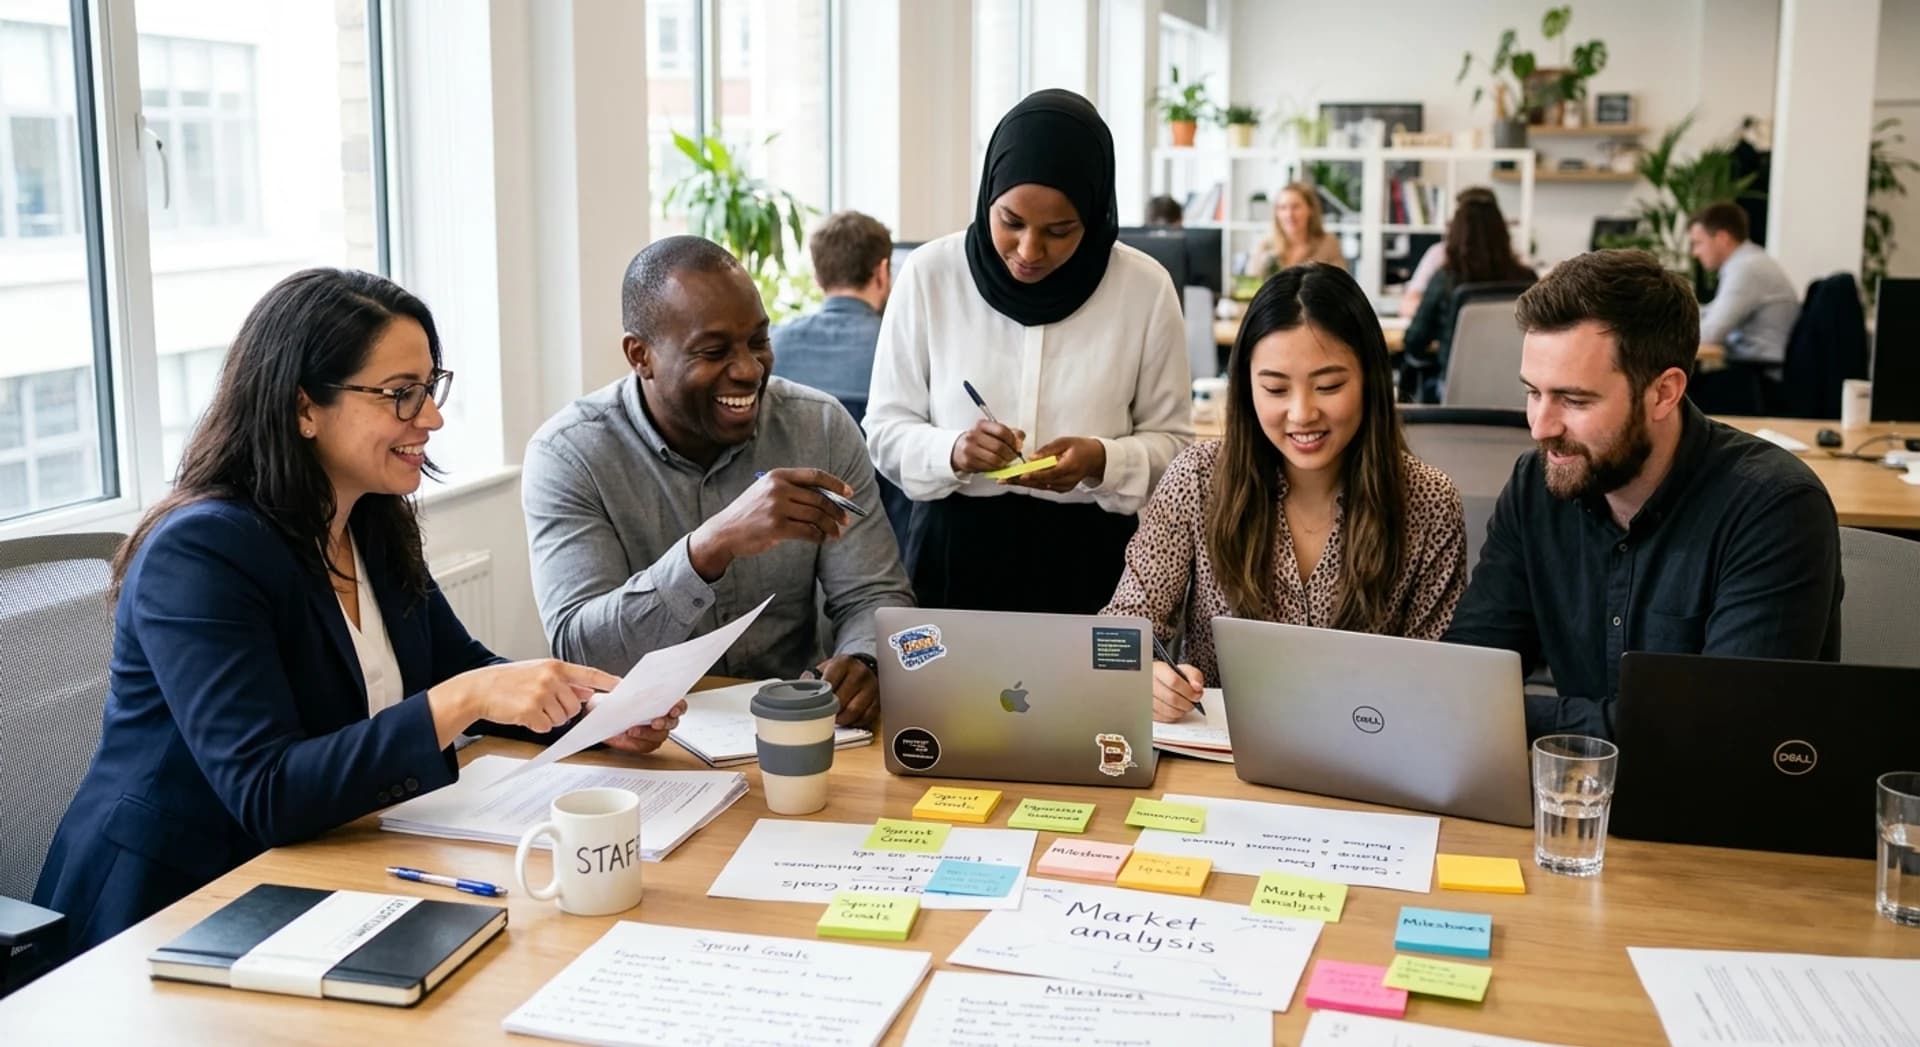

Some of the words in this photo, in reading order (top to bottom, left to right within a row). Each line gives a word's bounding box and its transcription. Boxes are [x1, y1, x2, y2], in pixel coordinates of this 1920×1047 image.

[1263, 884, 1327, 902] Market
[1065, 900, 1207, 931] Market
[1403, 917, 1486, 934] Milestones
[1069, 925, 1216, 953] analysis
[695, 938, 751, 953] Sprint
[760, 945, 808, 961] Goals
[1045, 984, 1145, 1001] Milestones
